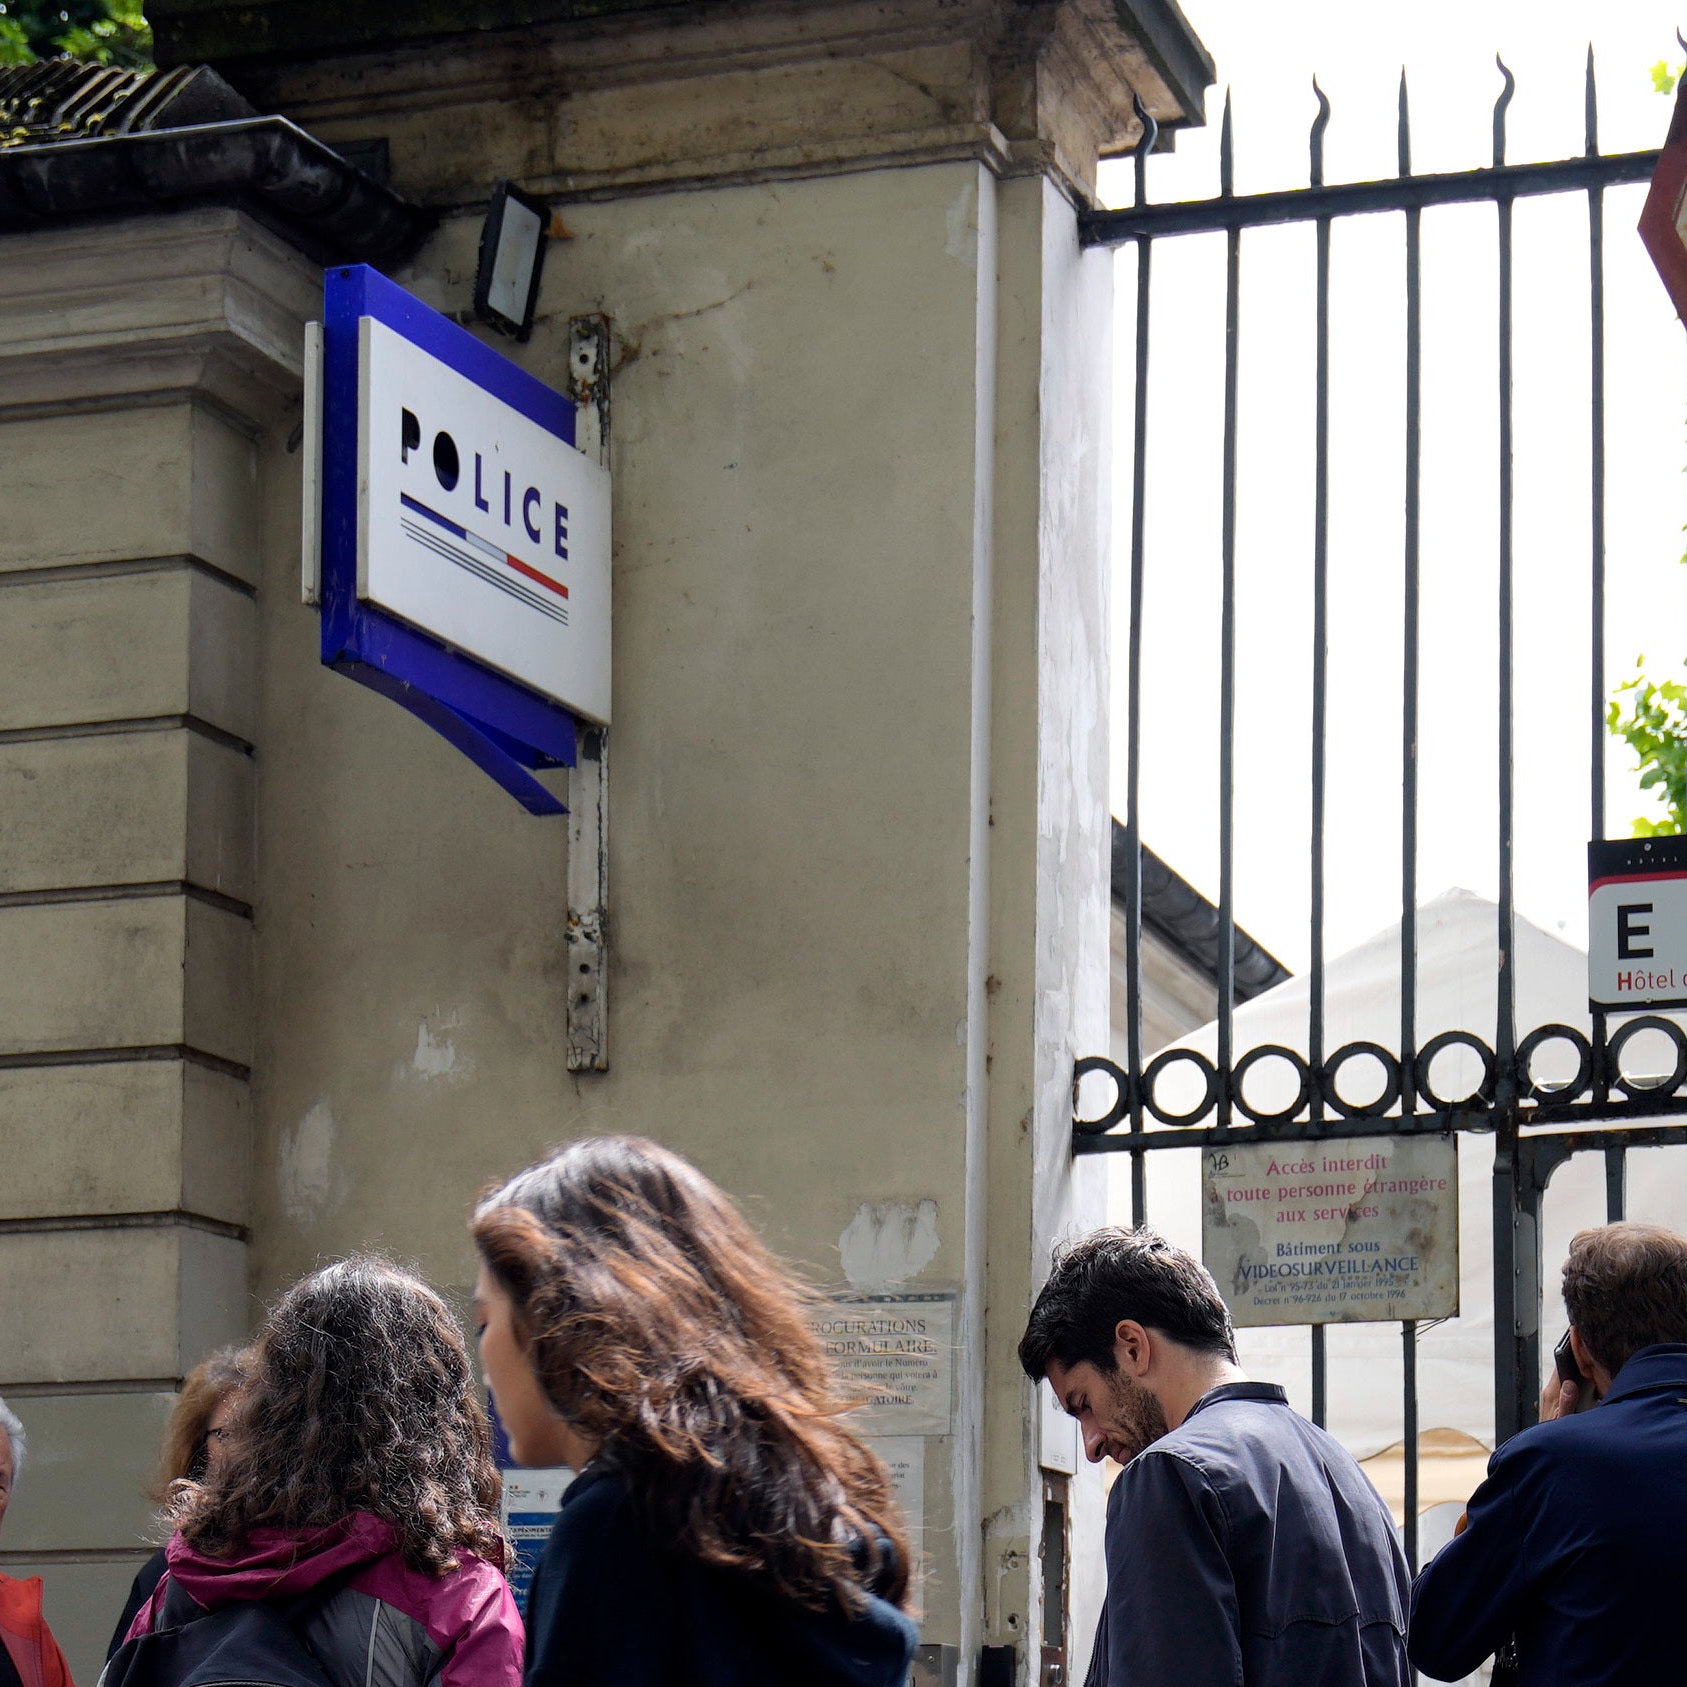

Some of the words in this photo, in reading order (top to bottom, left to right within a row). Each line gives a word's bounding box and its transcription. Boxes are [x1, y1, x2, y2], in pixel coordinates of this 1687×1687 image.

[400, 406, 570, 562] POLICE
[1617, 968, 1677, 992] Hôtel
[1266, 1157, 1316, 1177] Accès
[1322, 1153, 1388, 1172] interdit
[1227, 1187, 1271, 1202] toute
[1278, 1182, 1356, 1202] personne
[1363, 1175, 1447, 1195] étrangère
[1276, 1207, 1307, 1223] aux
[1313, 1203, 1380, 1222] services
[1276, 1241, 1343, 1258] Bâtiment
[1347, 1241, 1381, 1255] sous
[1240, 1256, 1419, 1280] VIDEOSURVEILLANCE
[1316, 1280, 1329, 1290] du
[1331, 1280, 1340, 1290] 21
[1375, 1277, 1394, 1288] 1995
[1253, 1296, 1281, 1306] Décret
[1325, 1293, 1336, 1303] du
[1338, 1291, 1347, 1301] 17
[1350, 1291, 1384, 1301] octobre
[1387, 1289, 1407, 1299] 1996
[885, 1358, 893, 1367] le
[889, 1370, 903, 1382] qui
